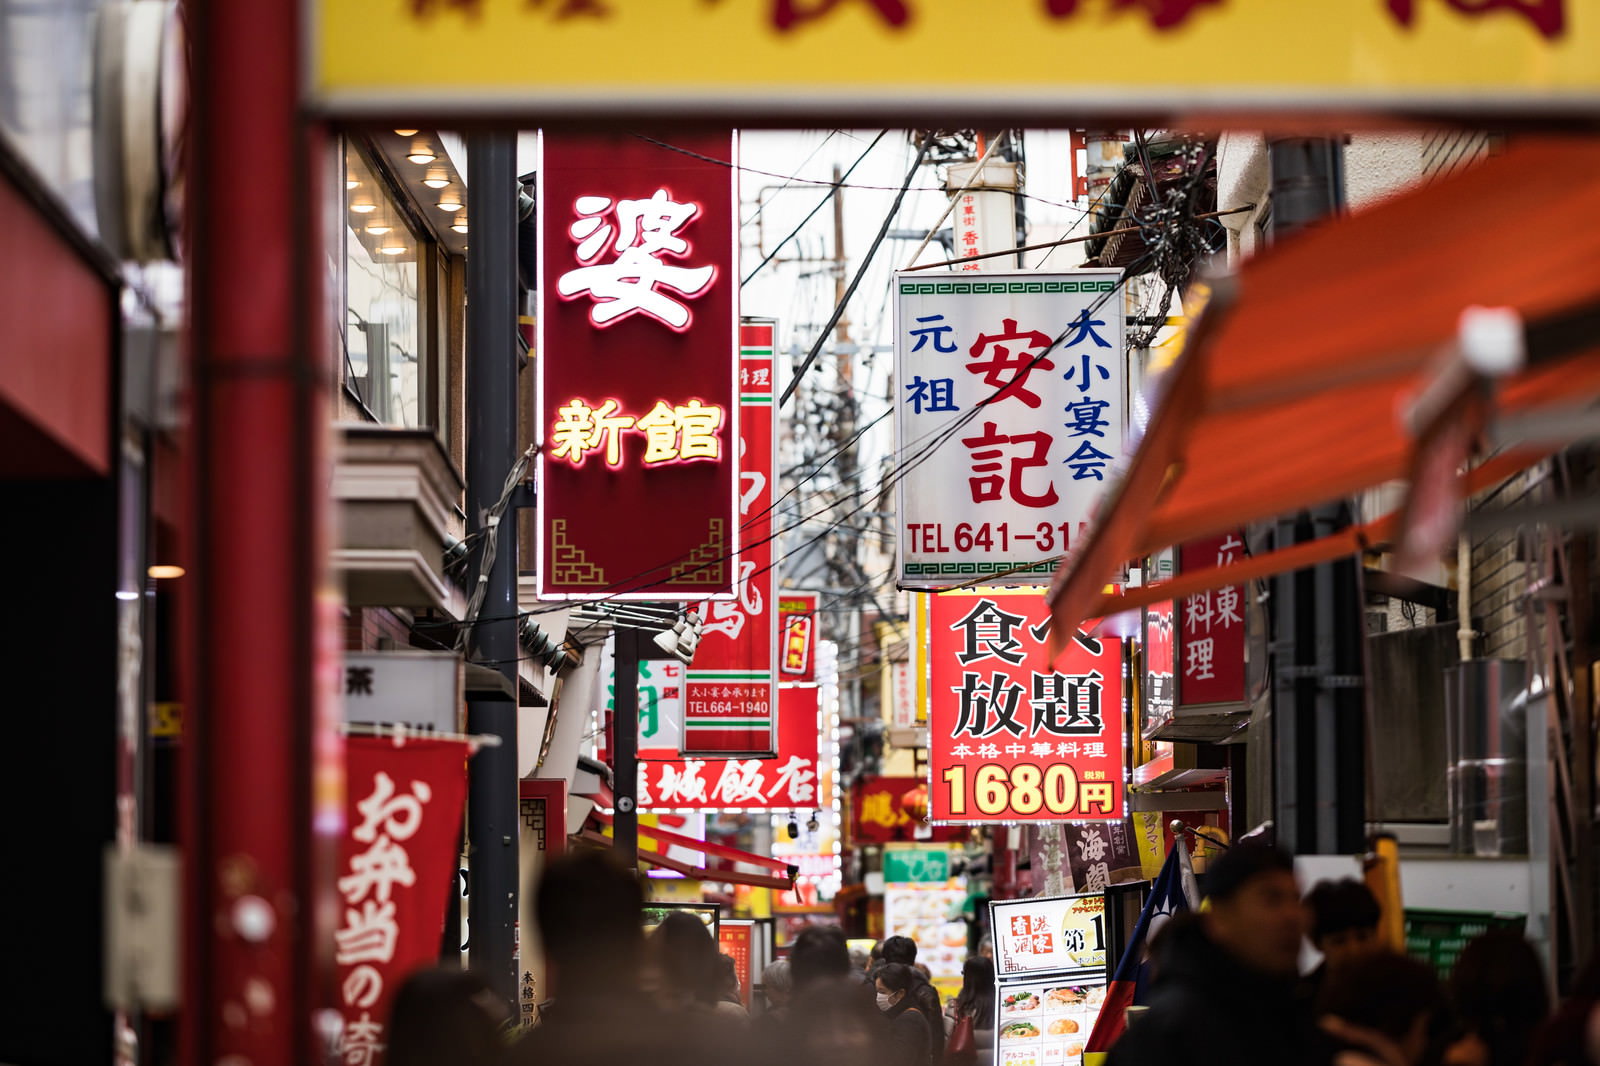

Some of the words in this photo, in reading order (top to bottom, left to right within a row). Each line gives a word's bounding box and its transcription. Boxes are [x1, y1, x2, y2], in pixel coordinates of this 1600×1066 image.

[557, 187, 716, 331] 婆
[904, 314, 959, 415] 元祖
[1062, 309, 1114, 481] 大小宴会
[550, 398, 722, 466] 新館
[961, 318, 1060, 508] 安記
[907, 524, 949, 553] TEL
[954, 522, 1088, 553] 641-31
[1184, 590, 1215, 681] 料理
[691, 687, 767, 698] 大小宴会承ります
[951, 671, 1104, 738] 放題
[950, 742, 1108, 759] 本格中華料理
[943, 763, 1115, 815] 1680円
[1076, 824, 1111, 892] 海閣
[1064, 914, 1106, 953] 第1
